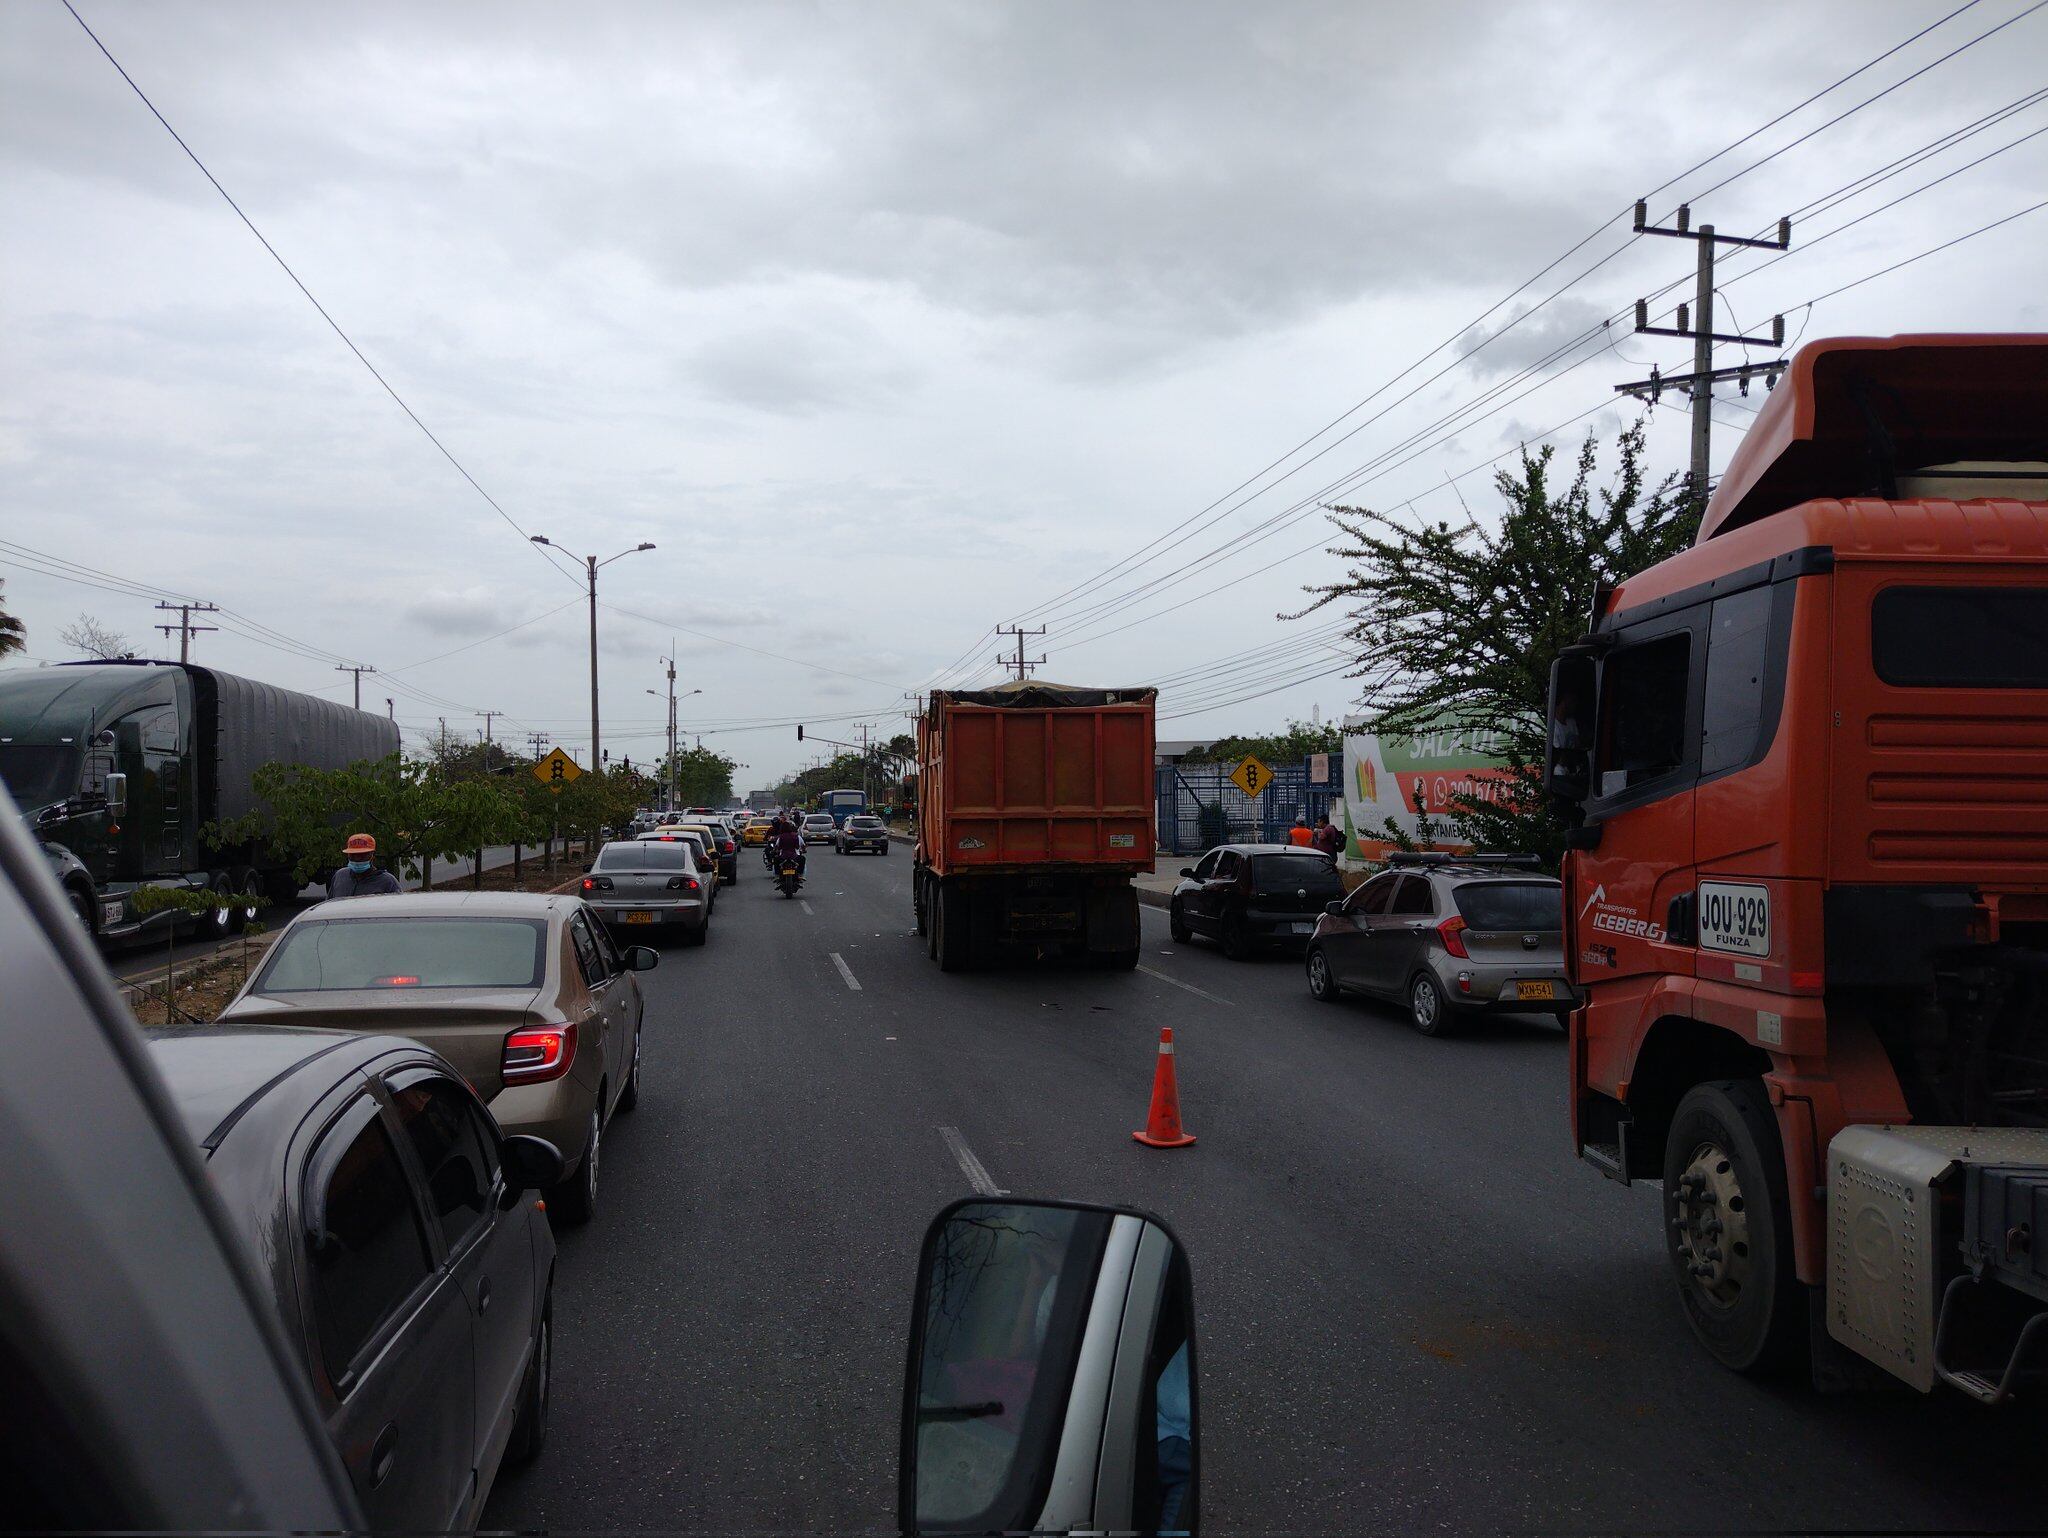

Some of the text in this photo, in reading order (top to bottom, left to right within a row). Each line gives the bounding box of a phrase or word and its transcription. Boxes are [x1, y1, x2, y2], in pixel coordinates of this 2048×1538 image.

[1409, 727, 1465, 759] SALA
[1415, 823, 1481, 839] ARTAMENOS
[1597, 902, 1638, 916] TRANSPORTES
[1593, 912, 1662, 939] ICEBERG
[1716, 934, 1751, 947] FUNZA
